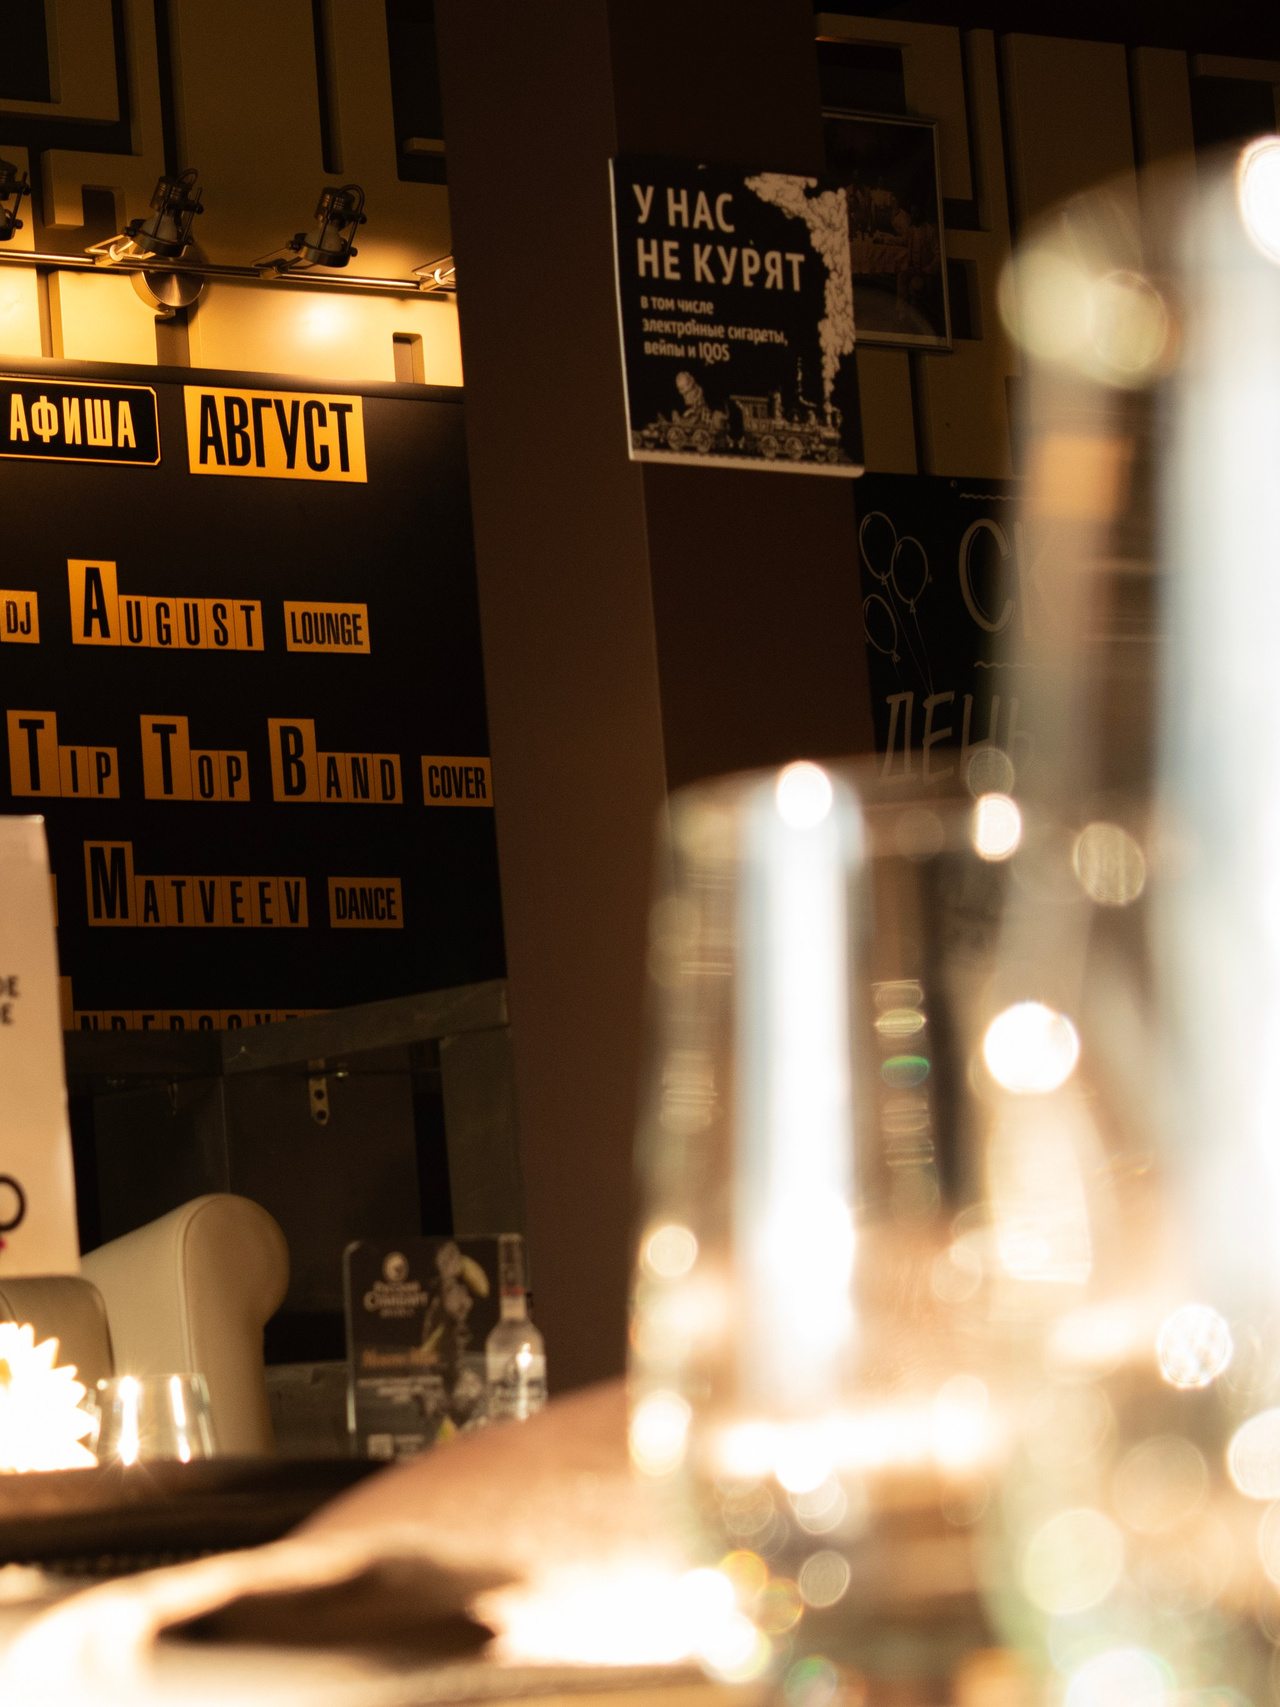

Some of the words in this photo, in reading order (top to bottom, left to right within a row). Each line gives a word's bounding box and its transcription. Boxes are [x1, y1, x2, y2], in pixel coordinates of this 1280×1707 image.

[632, 184, 655, 224] У
[666, 187, 736, 234] НАС
[636, 237, 682, 282] НЕ
[693, 242, 806, 292] КУРЯТ
[650, 296, 675, 312] том
[677, 298, 715, 316] числе
[643, 339, 686, 358] вейпы
[687, 345, 697, 359] и
[698, 341, 731, 367] IQOS
[9, 392, 137, 449] АФИША
[199, 393, 354, 473] АВГУСТ
[5, 600, 32, 636] DJ
[290, 611, 364, 647] LOUNGE
[427, 764, 488, 800] COVER
[334, 886, 398, 922] DANCE
